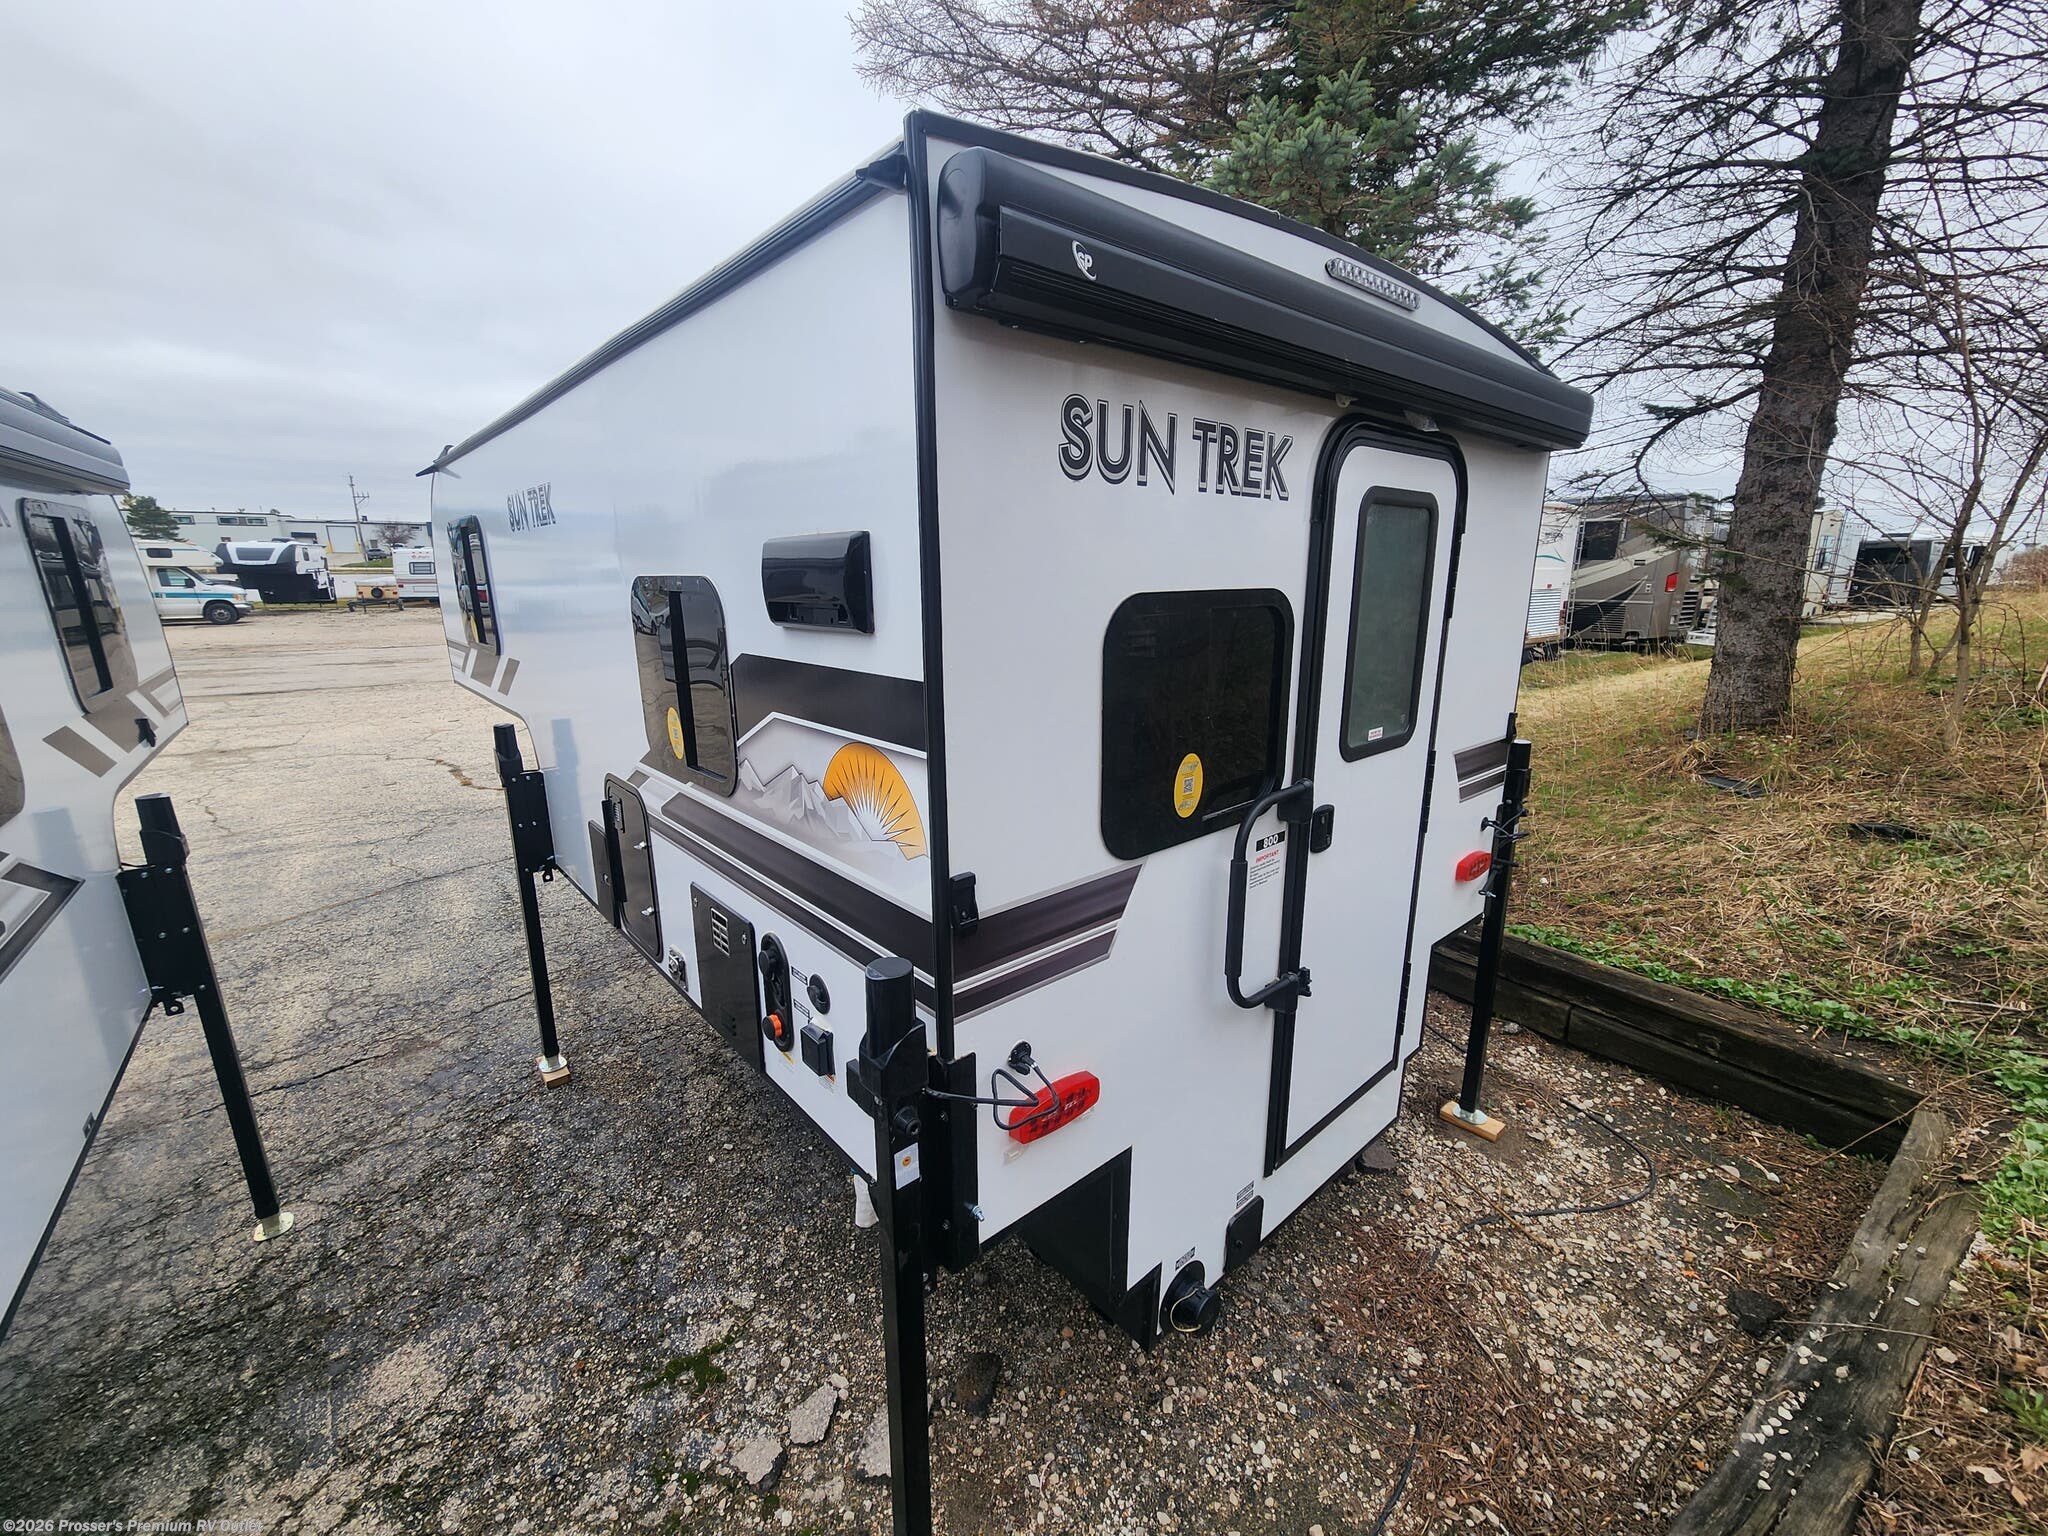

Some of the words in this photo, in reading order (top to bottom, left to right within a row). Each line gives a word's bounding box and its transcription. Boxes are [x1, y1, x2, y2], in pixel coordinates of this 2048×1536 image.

[1058, 393, 1178, 496] SUN
[1192, 417, 1294, 502] TREK
[506, 491, 530, 533] SUN
[527, 482, 556, 528] TREK
[1263, 834, 1279, 849] 800
